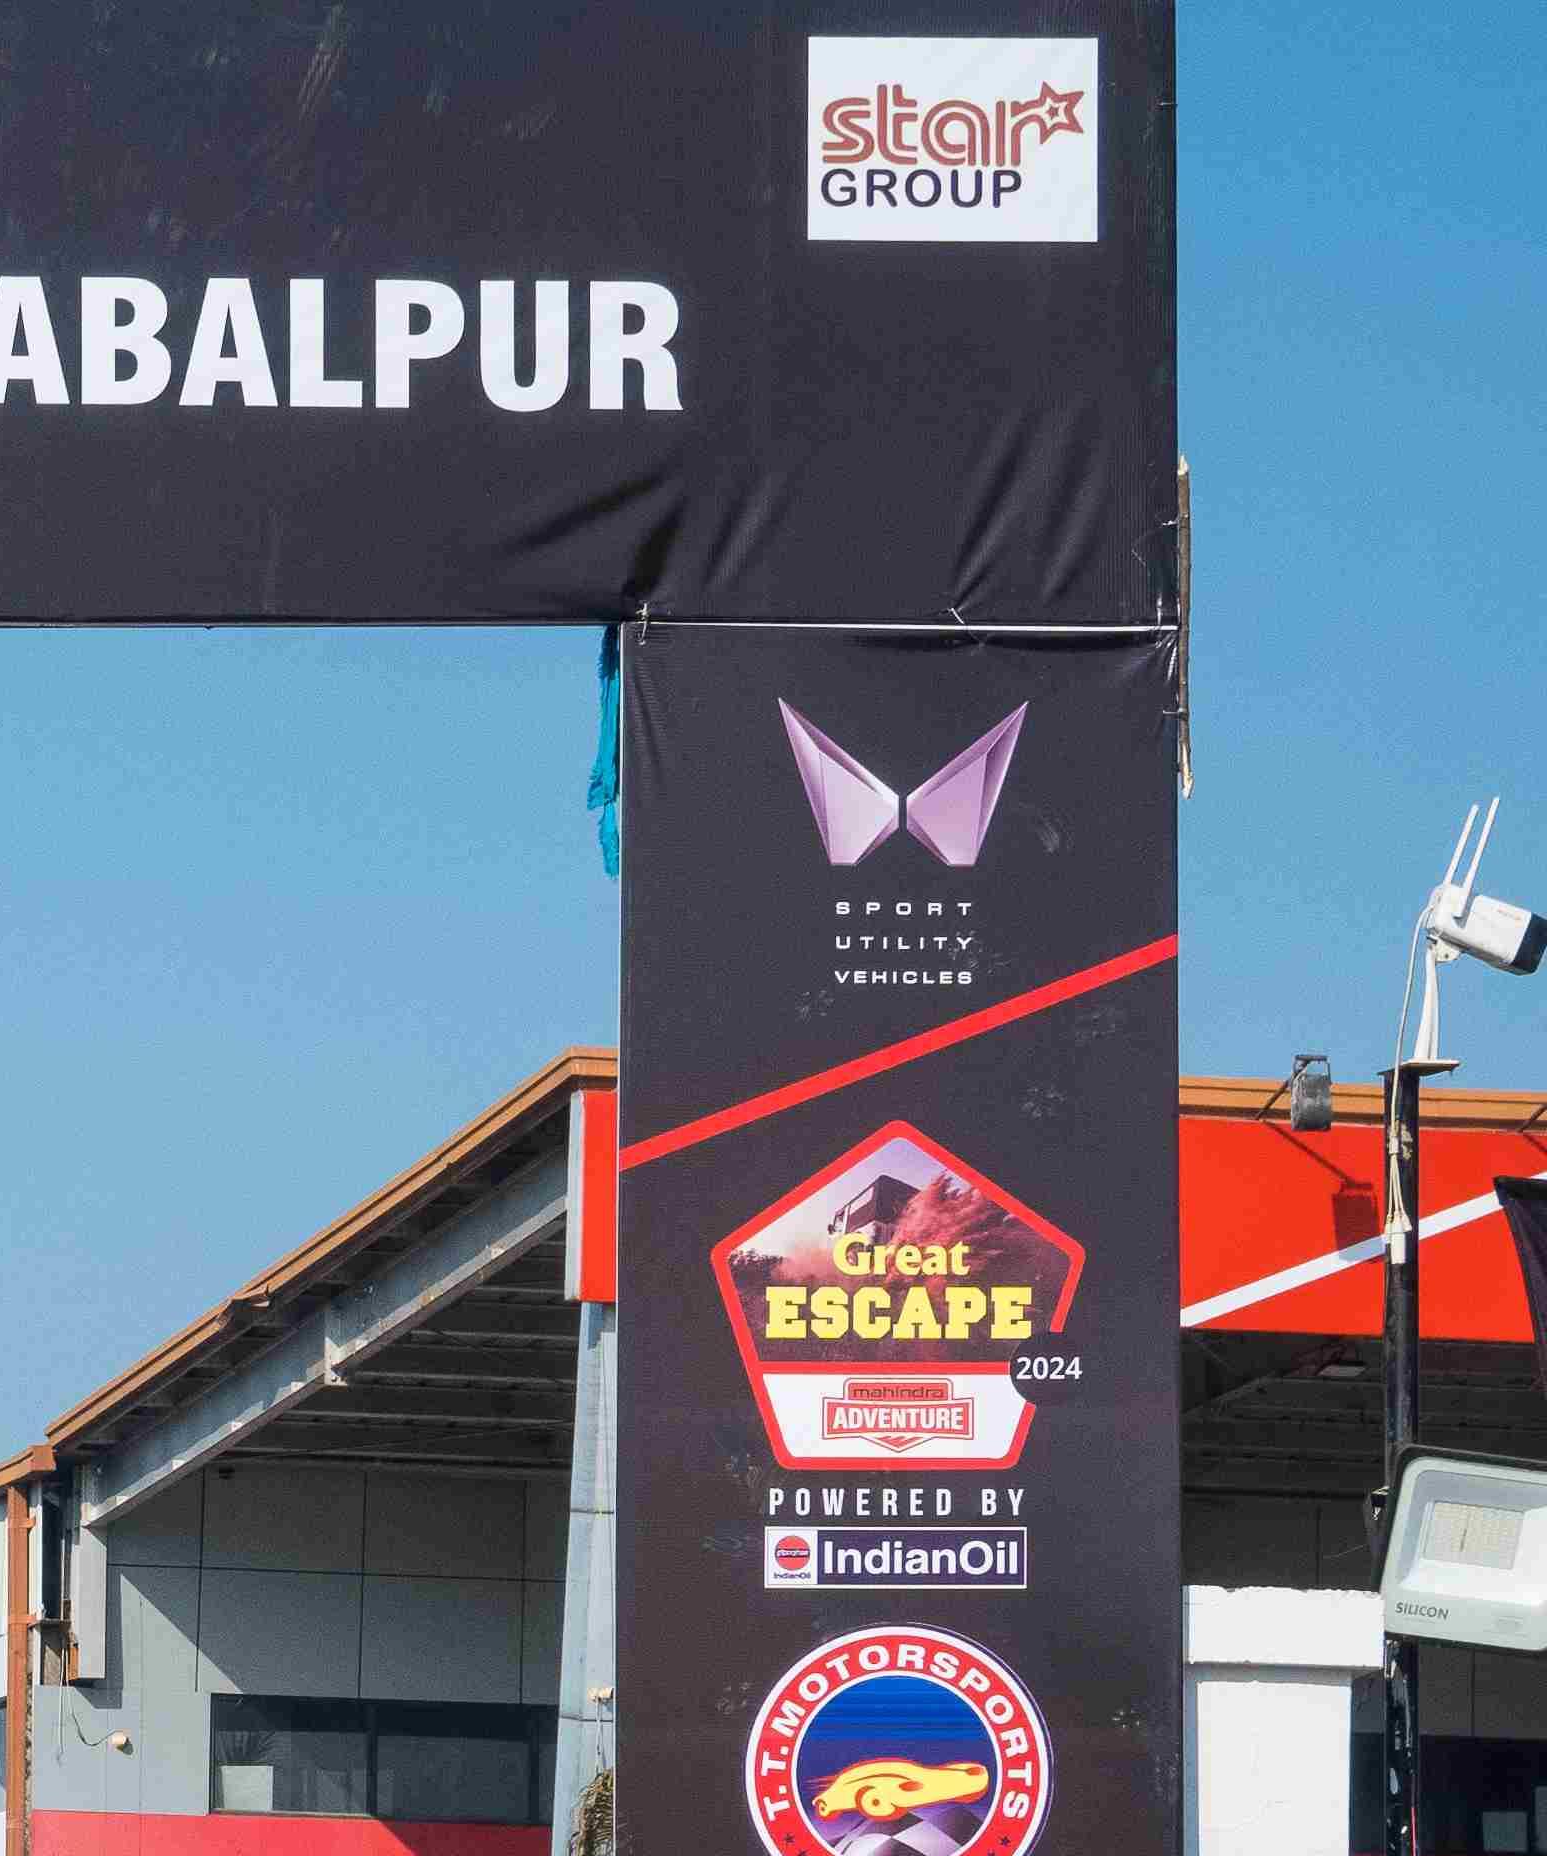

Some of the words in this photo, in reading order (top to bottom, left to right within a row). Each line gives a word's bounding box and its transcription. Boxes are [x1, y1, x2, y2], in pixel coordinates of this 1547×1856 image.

[821, 168, 1022, 208] GROUP
[835, 901, 972, 916] SPORT
[835, 935, 973, 950] UTILITY
[834, 970, 972, 985] VEHICLES
[833, 1233, 970, 1276] Great
[765, 1287, 1032, 1339] ESCAPE
[1016, 1356, 1083, 1380] 2024
[851, 1384, 944, 1399] mahindra
[833, 1407, 964, 1430] ADVENTURE
[769, 1487, 952, 1516] POWERED
[981, 1488, 1024, 1516] BY
[823, 1540, 1018, 1575] IndianOil
[1395, 1602, 1449, 1620] SILICON
